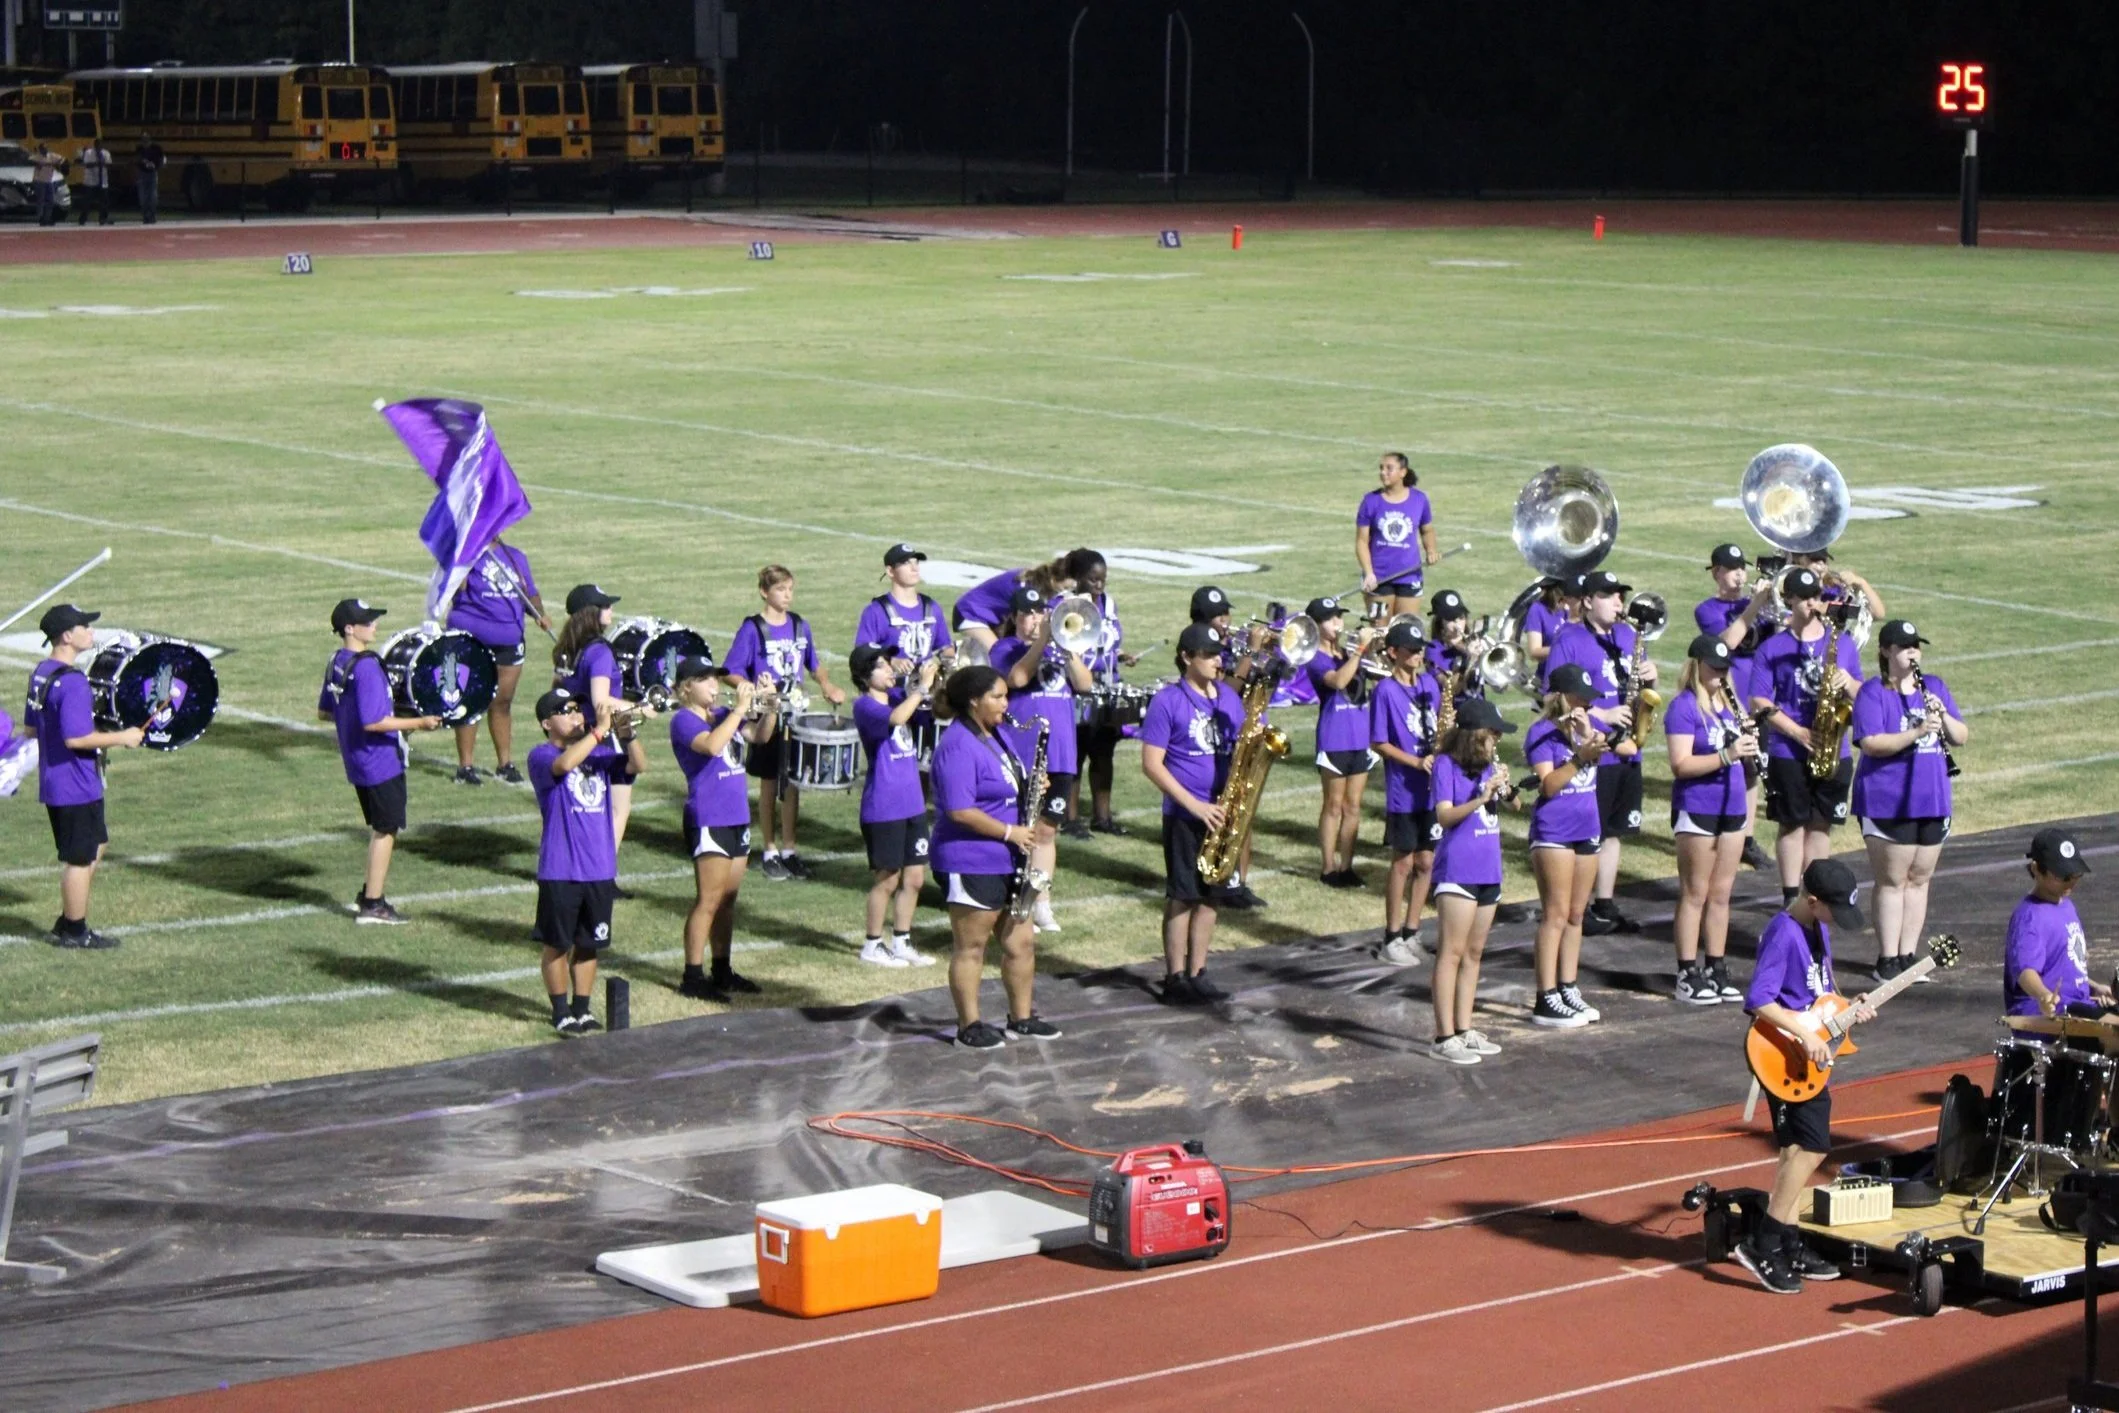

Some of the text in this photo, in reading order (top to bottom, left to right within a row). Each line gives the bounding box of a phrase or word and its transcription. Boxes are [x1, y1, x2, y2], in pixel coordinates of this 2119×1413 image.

[1939, 64, 1985, 111] 25
[754, 242, 772, 258] 10
[291, 255, 310, 272] 20
[2031, 1276, 2066, 1294] JARVIS
